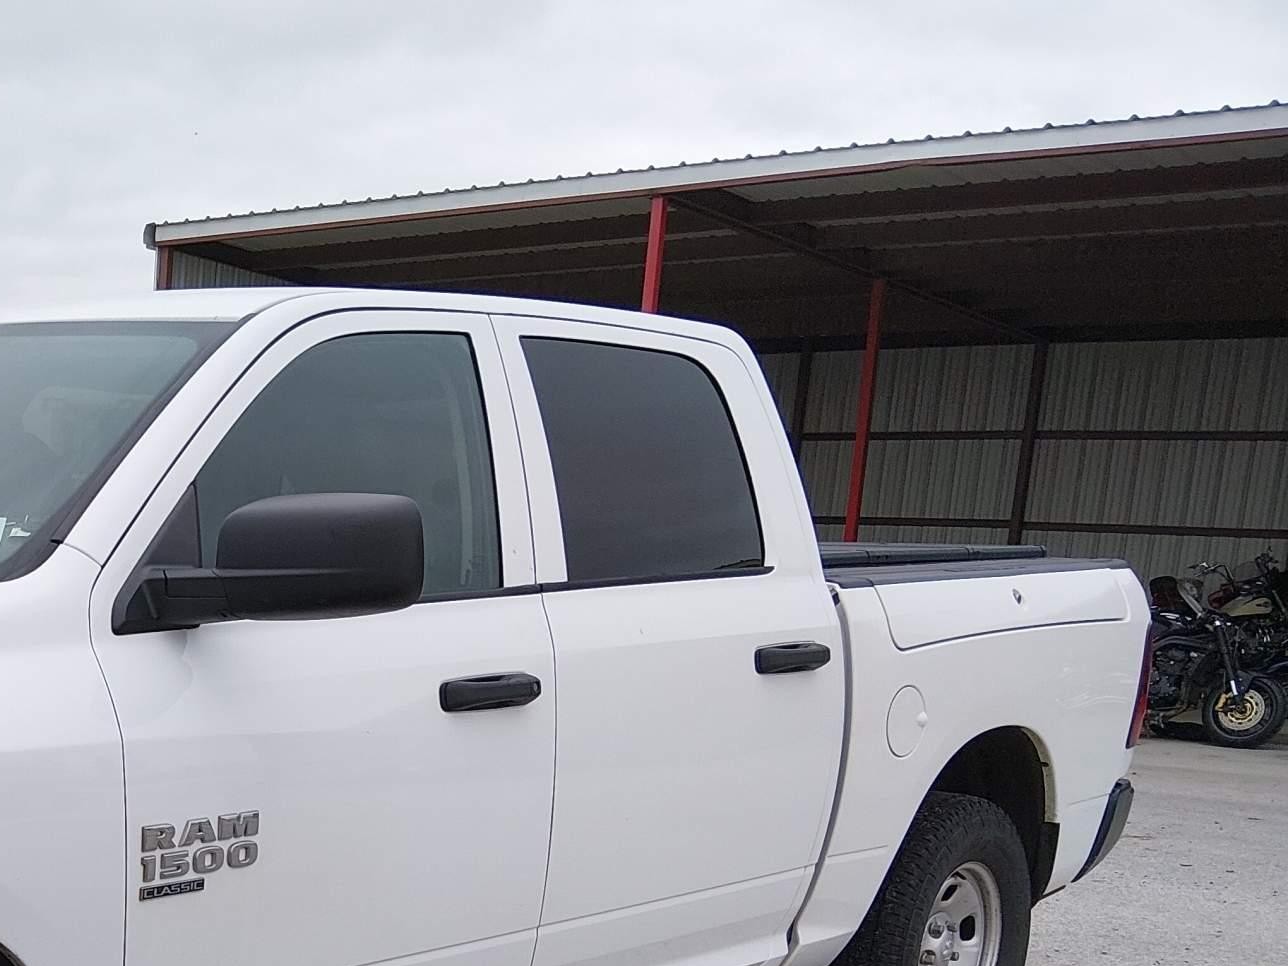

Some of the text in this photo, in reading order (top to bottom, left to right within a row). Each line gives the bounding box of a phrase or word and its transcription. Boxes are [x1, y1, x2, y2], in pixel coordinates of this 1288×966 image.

[141, 810, 260, 853] RAM
[140, 840, 259, 883] 1500
[143, 879, 204, 899] CLASSIC
